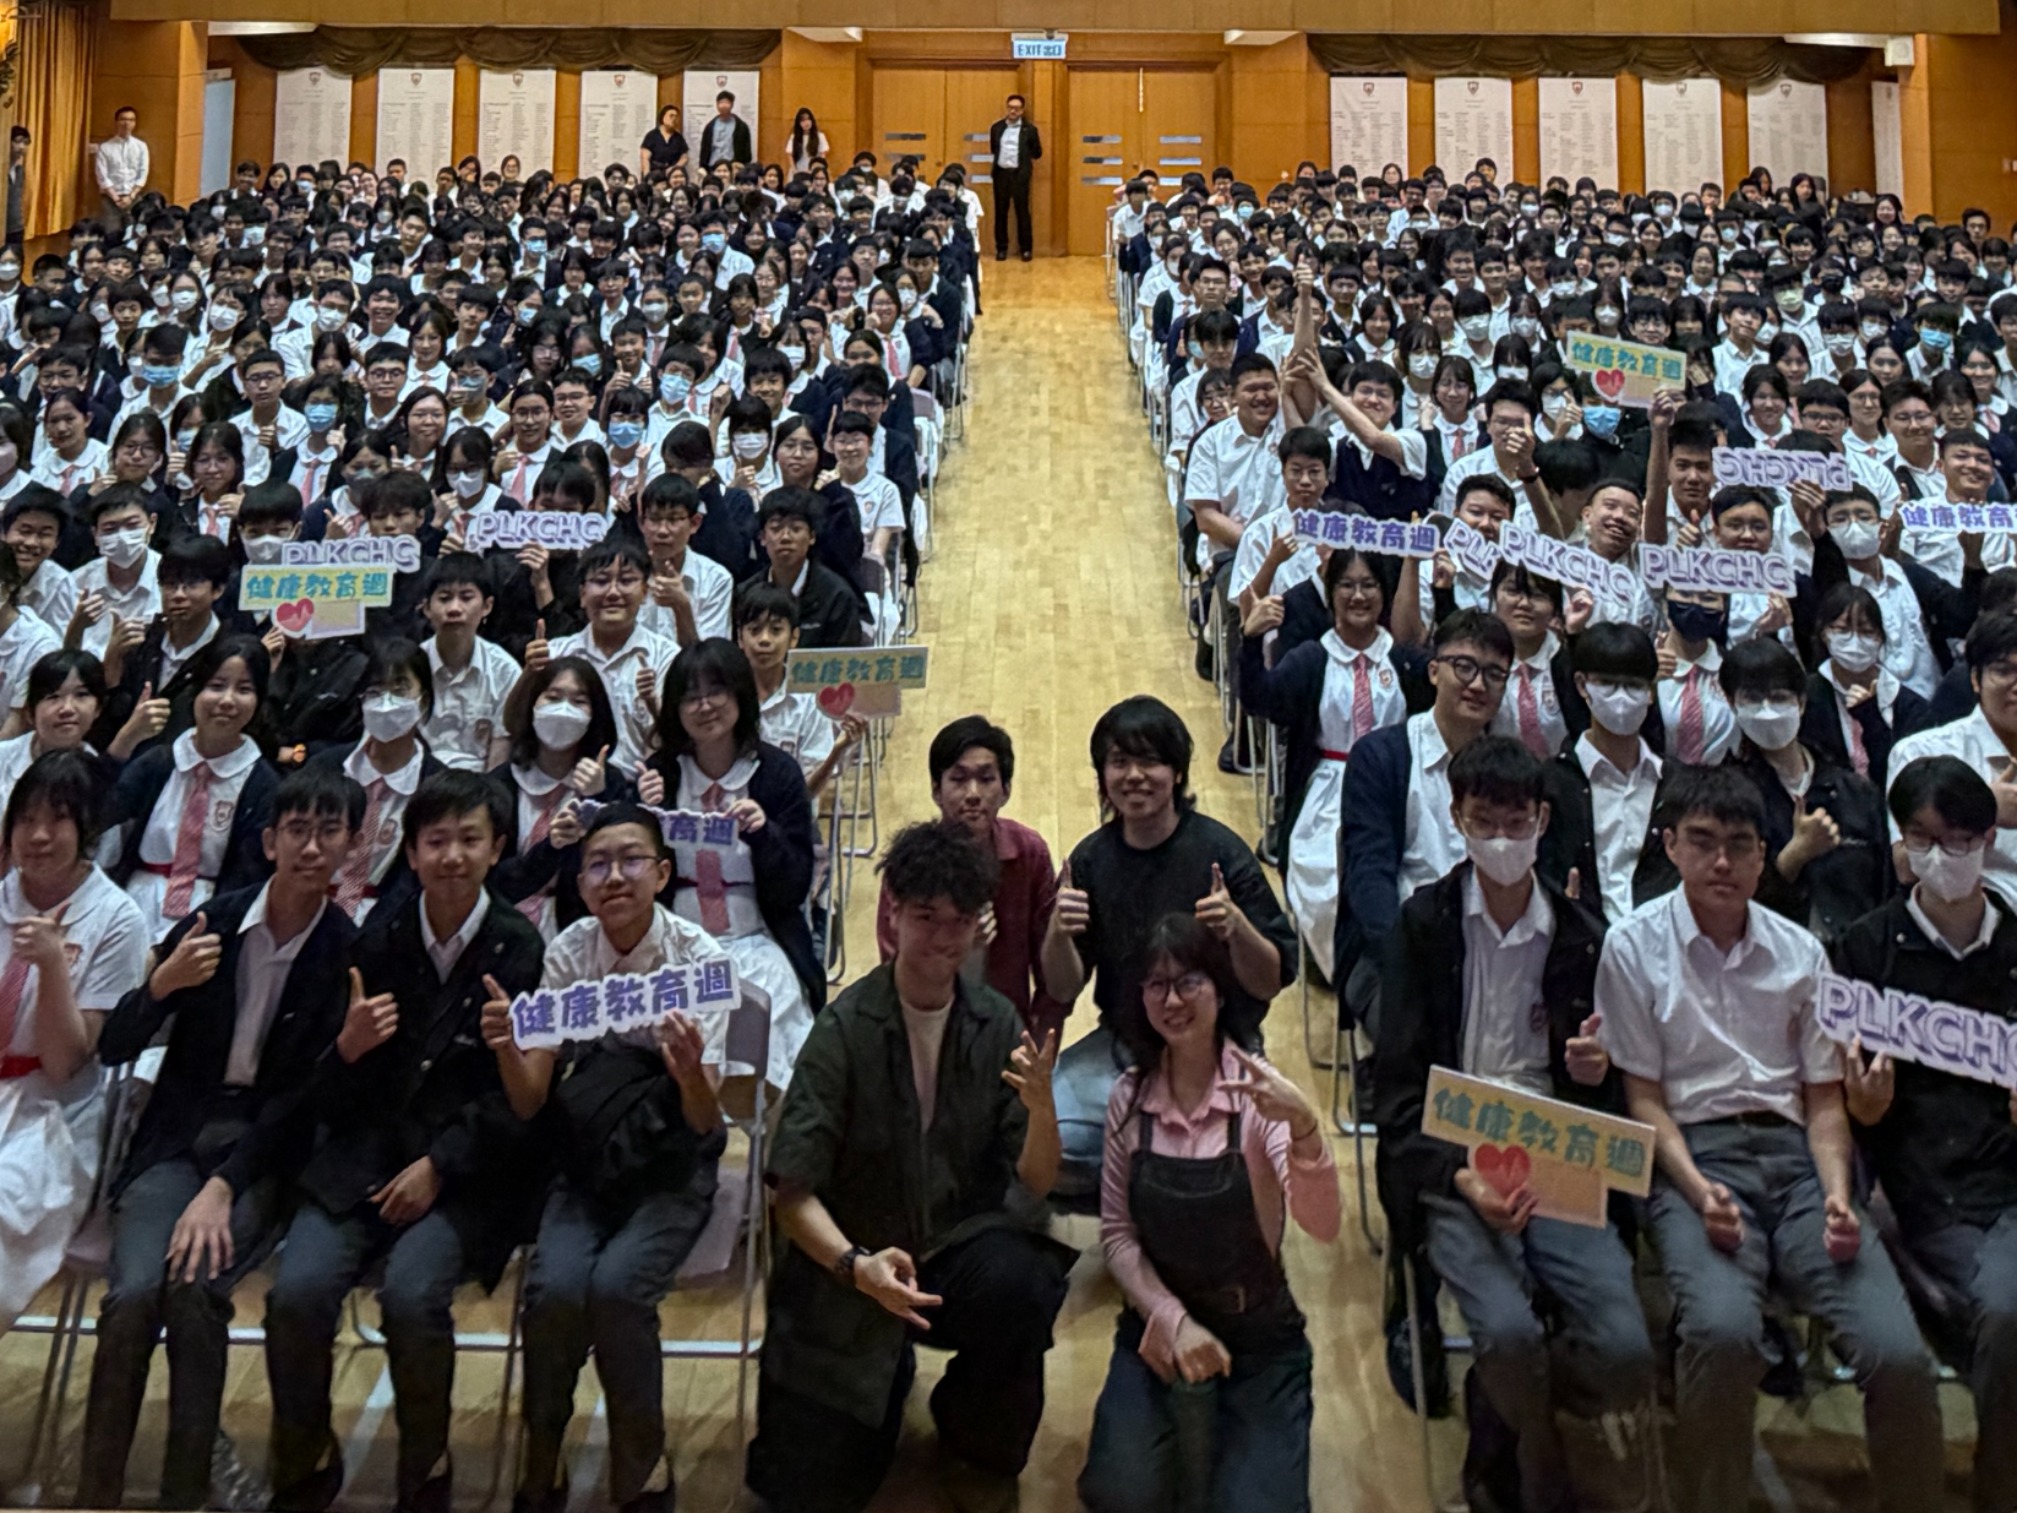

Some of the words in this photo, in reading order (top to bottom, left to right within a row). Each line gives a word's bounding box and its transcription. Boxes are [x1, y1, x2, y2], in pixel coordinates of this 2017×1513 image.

[1017, 43, 1041, 56] EXIT
[1572, 342, 1681, 380] 健康教育週
[477, 512, 604, 545] PLKCHC
[1293, 510, 1436, 552] 健康教育週
[1902, 504, 2017, 528] 健康教育
[1502, 523, 1634, 600] PLKCHC
[1644, 547, 1791, 590] PLKCHC
[247, 571, 388, 599] 健康教育週
[792, 655, 925, 683] 健康教育週
[514, 959, 733, 1038] 健康教育週
[1434, 1087, 1645, 1177] 健康教育週
